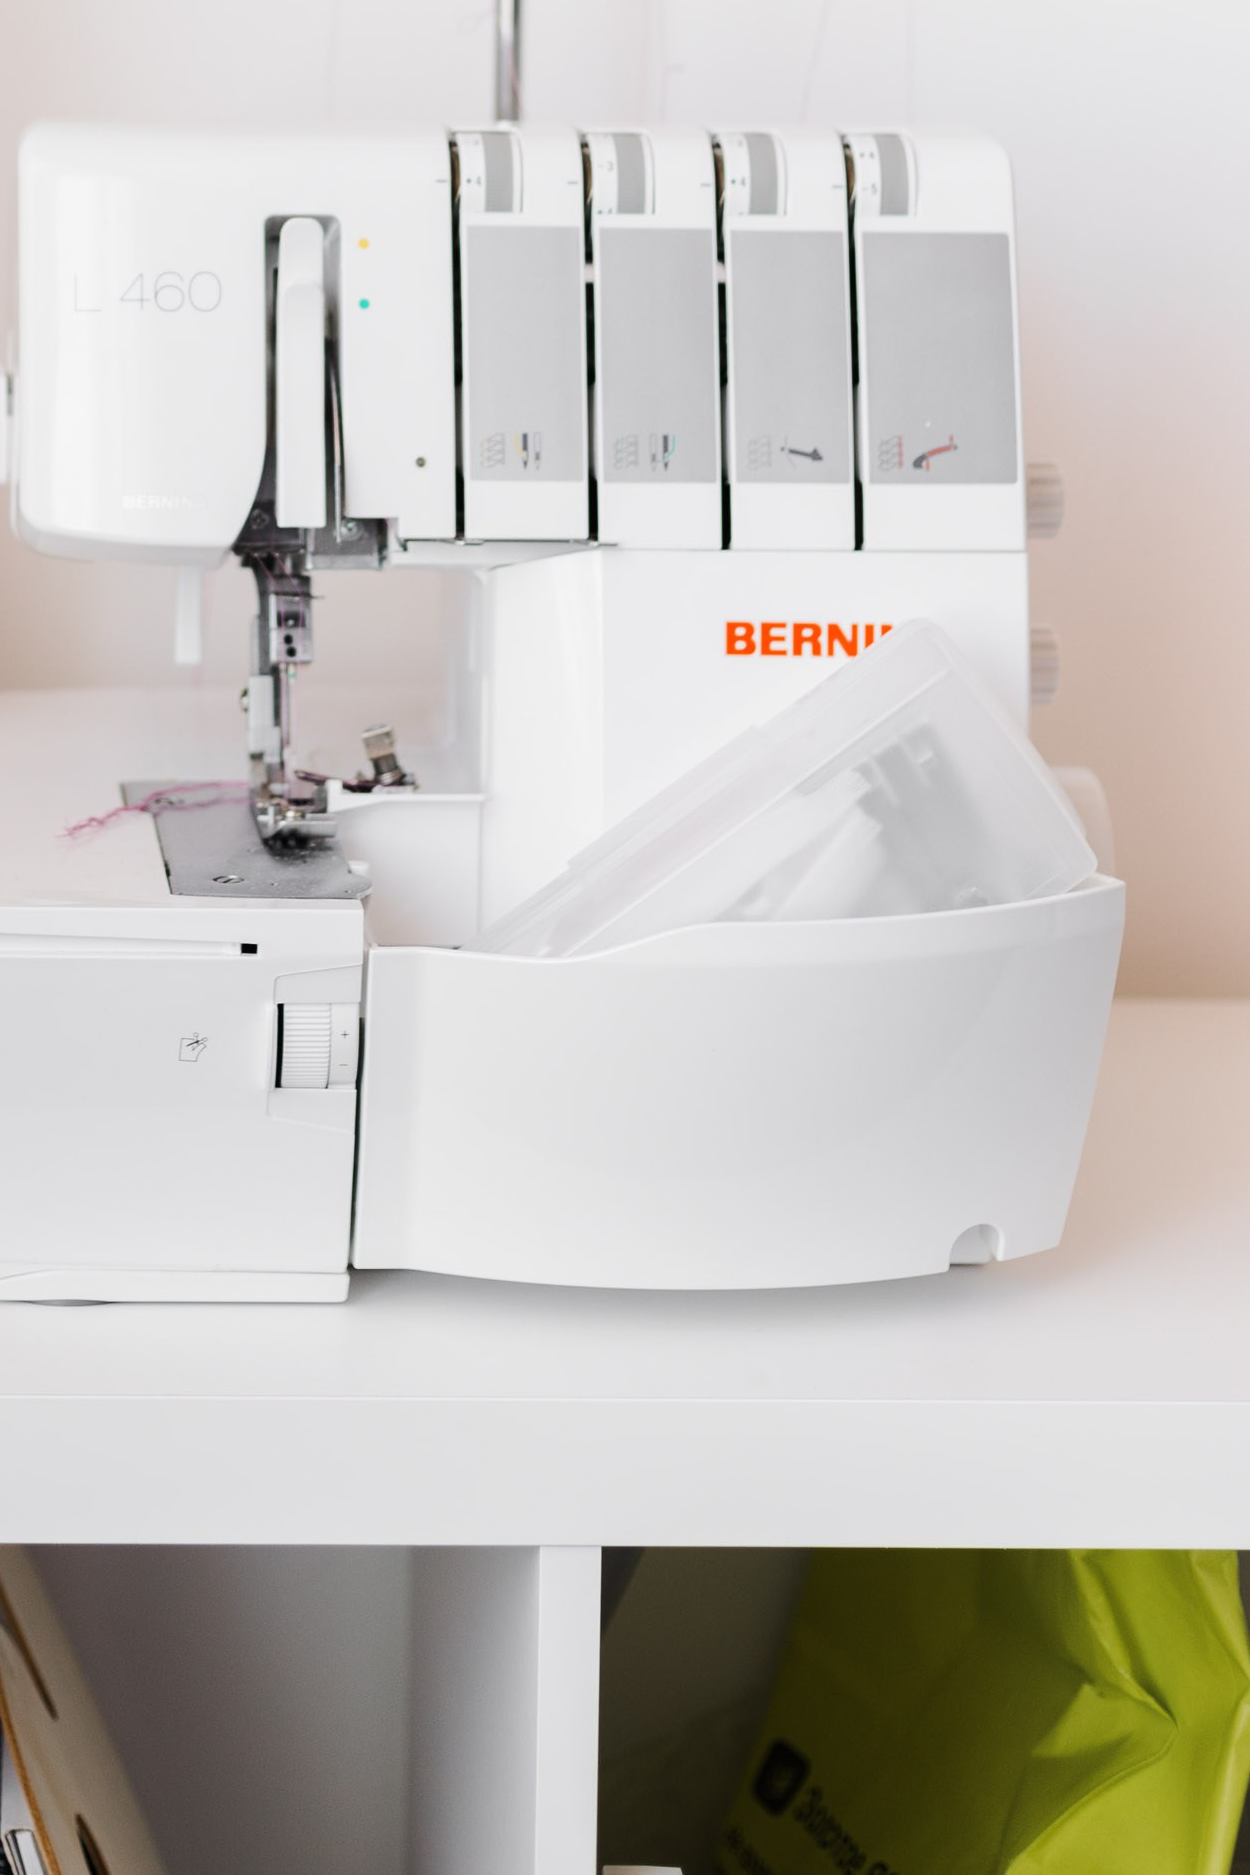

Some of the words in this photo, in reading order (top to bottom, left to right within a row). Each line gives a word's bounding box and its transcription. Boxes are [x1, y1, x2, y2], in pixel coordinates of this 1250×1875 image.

[73, 272, 102, 313] L
[119, 270, 223, 313] 460
[725, 621, 893, 657] BERNI
